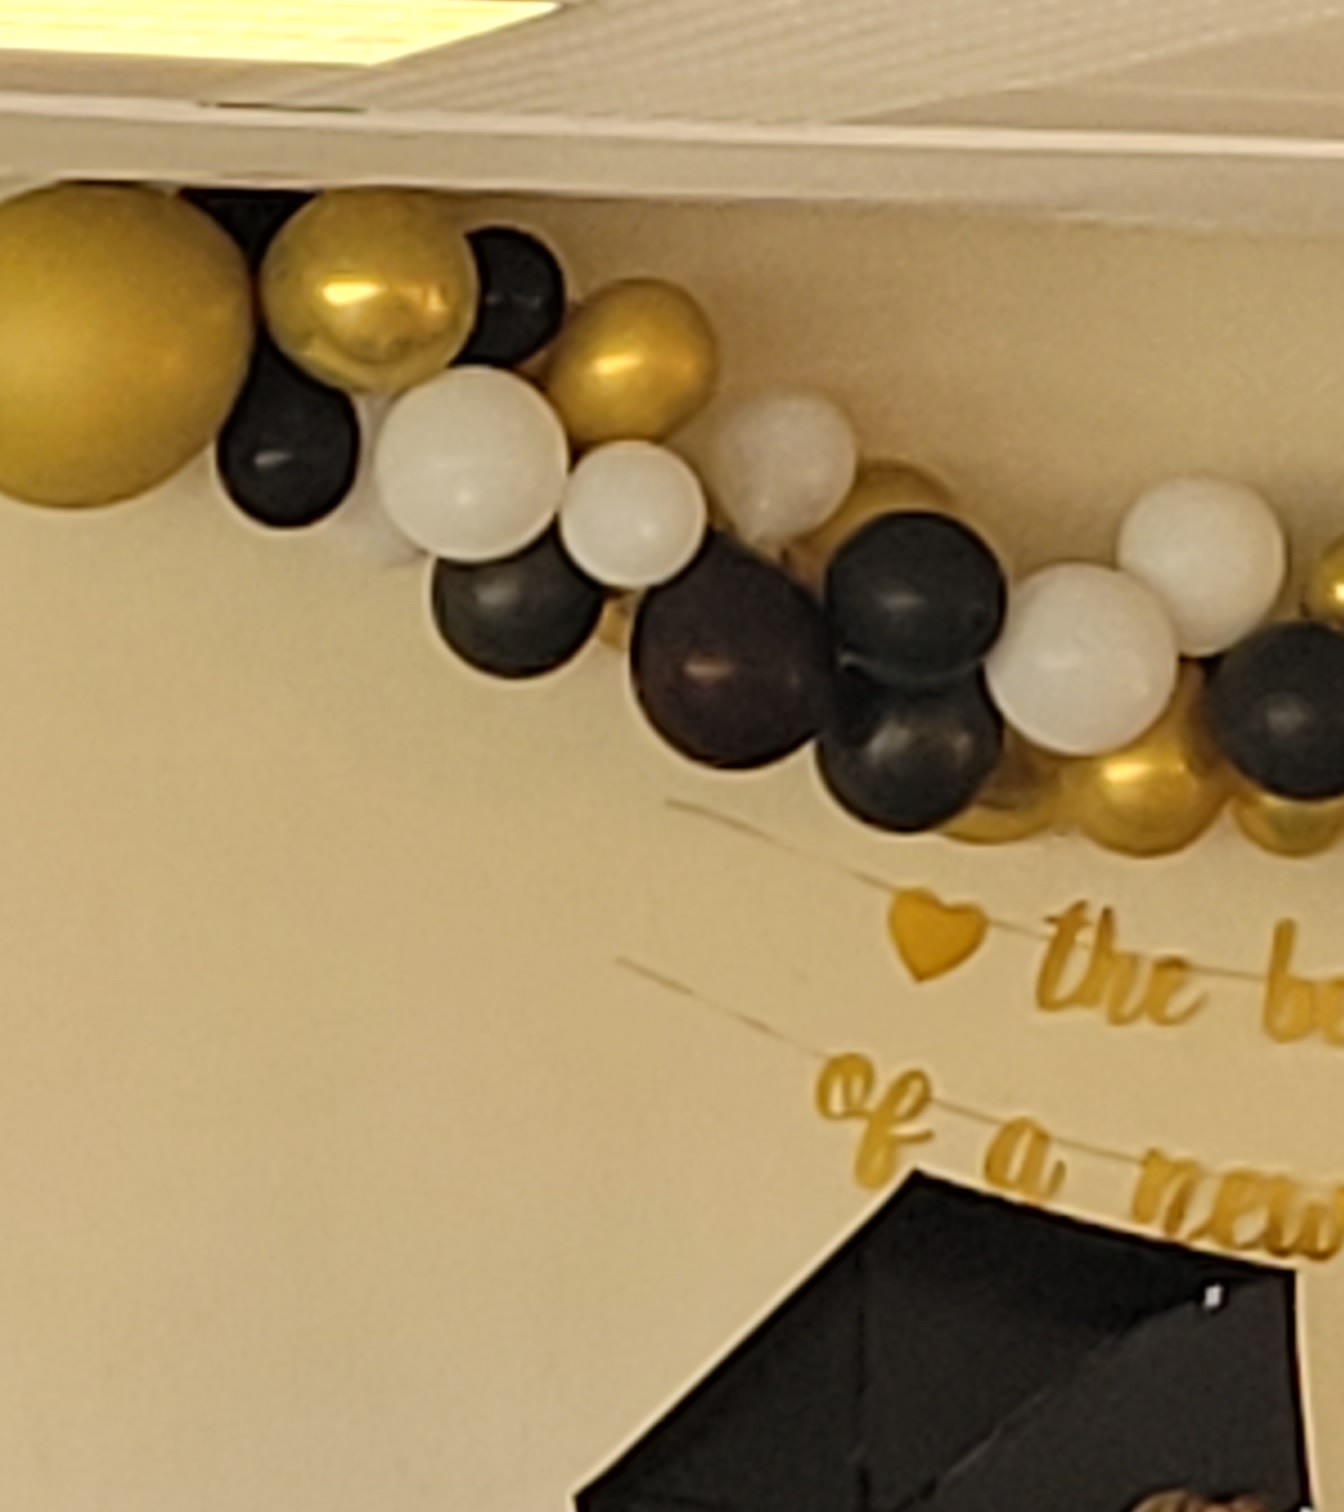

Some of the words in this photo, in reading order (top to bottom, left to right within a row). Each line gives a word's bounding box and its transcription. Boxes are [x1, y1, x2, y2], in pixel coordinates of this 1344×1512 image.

[1036, 900, 1207, 1026] the
[815, 1053, 934, 1190] of
[985, 1117, 1066, 1205] a
